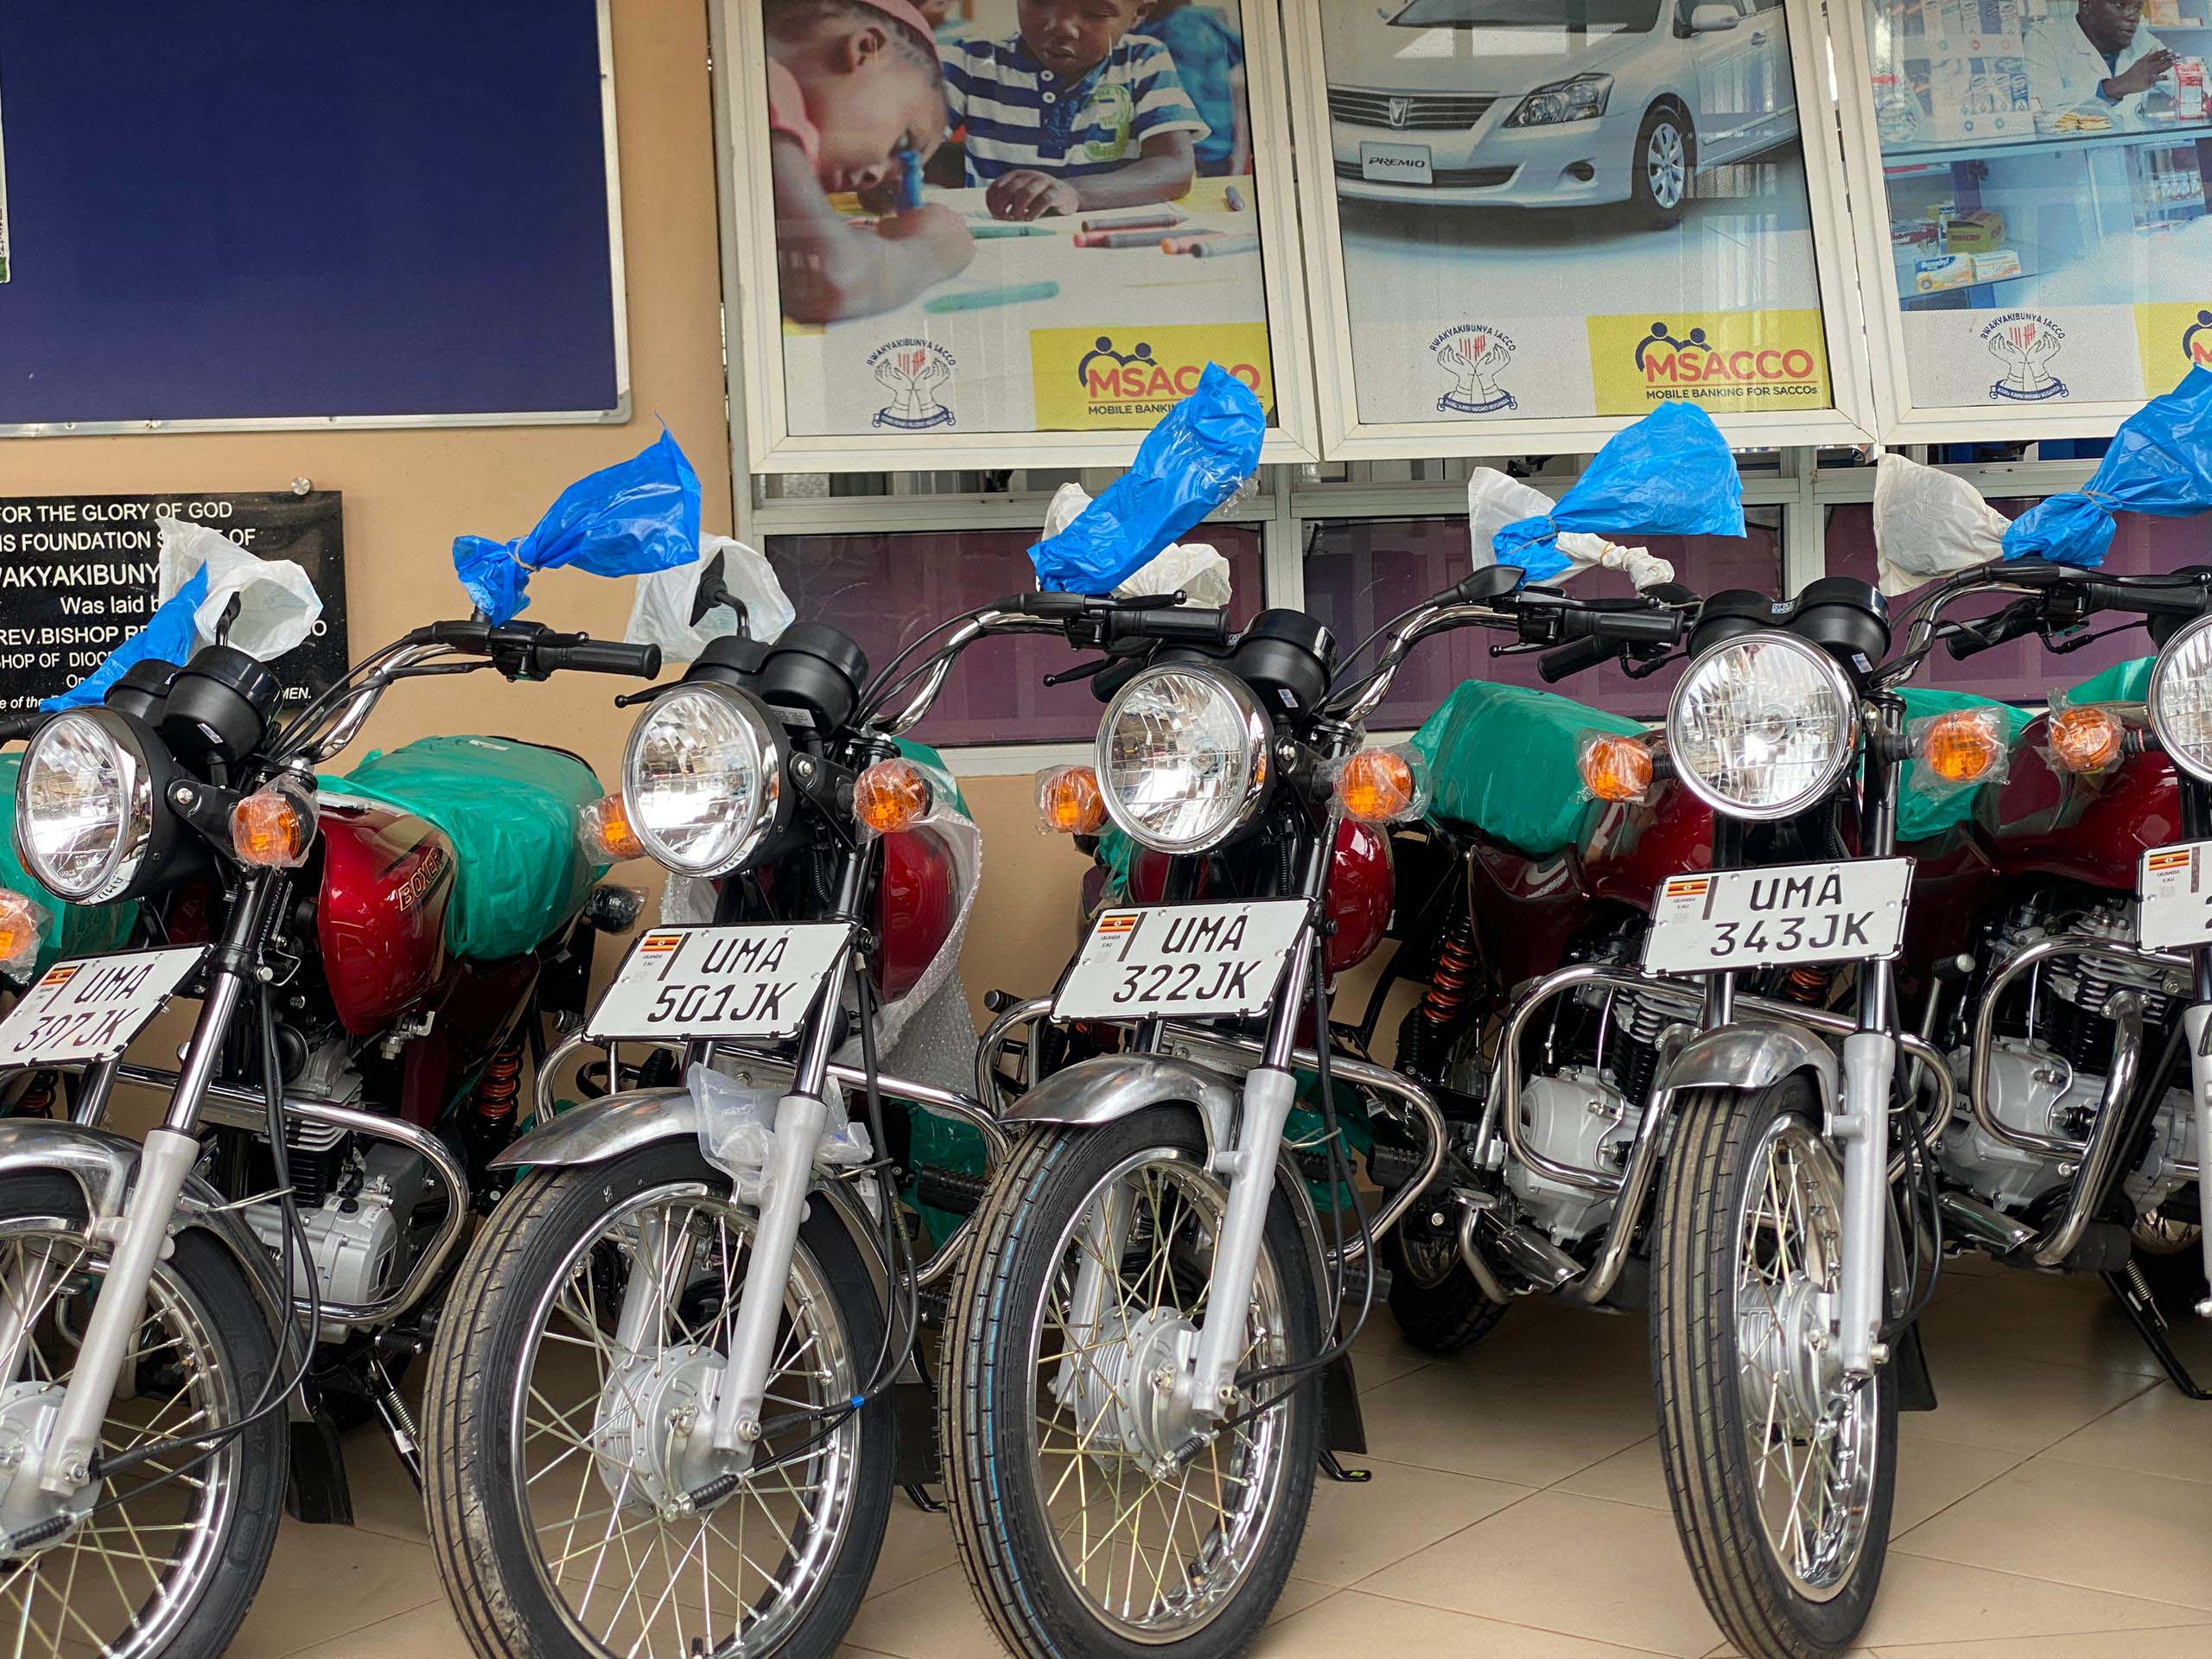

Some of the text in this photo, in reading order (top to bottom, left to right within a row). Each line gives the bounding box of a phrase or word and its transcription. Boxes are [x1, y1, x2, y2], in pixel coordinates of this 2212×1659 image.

[1368, 156, 1426, 168] PREMIO
[1494, 330, 1516, 352] SACCO
[2043, 318, 2066, 340] SACCO
[934, 344, 957, 366] SACCO
[1645, 349, 1814, 383] MSACCO
[1089, 364, 1260, 397] MSACO
[1646, 389, 1689, 399] MOBILE
[1694, 388, 1744, 398] BANKING
[1747, 387, 1770, 397] FOR
[1089, 404, 1176, 415] MOBILE BANKI
[0, 501, 232, 523] OR THE GLORY OF GOD
[22, 531, 151, 551] FOUNDATION
[229, 528, 256, 546] OF
[0, 563, 160, 588] AKYAKIBUNY
[60, 596, 105, 614] Was
[111, 595, 143, 613] laid
[0, 653, 34, 669] HOP
[39, 652, 60, 668] OF
[10, 696, 24, 709] of
[398, 847, 443, 912] BOXER
[1750, 874, 1842, 911] UMA
[1160, 915, 1249, 954] UMA
[1710, 912, 1875, 957] 343JK
[701, 938, 789, 974] UMA
[74, 963, 155, 1004] UMA
[1113, 961, 1262, 1002] 322JK
[647, 982, 798, 1022] 501JK
[13, 1007, 140, 1052] 397JK
